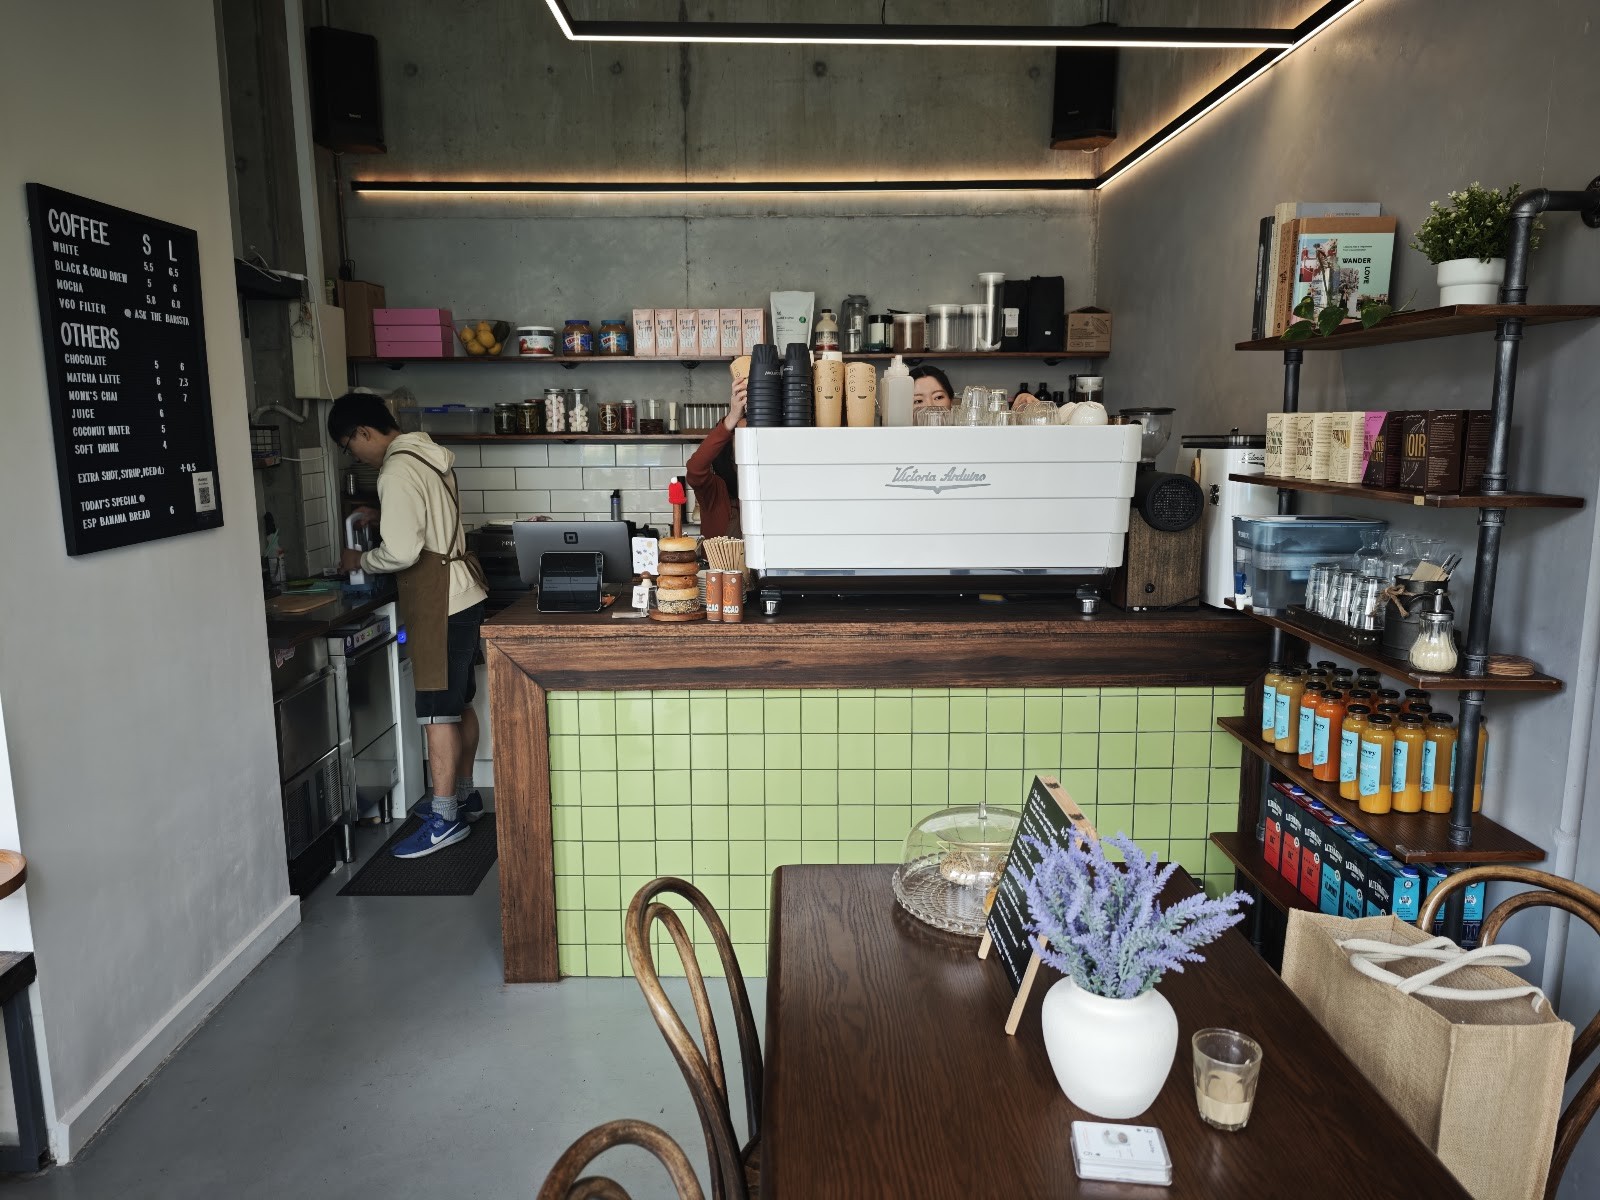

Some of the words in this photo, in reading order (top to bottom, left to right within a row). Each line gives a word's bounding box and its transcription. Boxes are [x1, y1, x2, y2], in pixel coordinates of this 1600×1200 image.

[48, 208, 110, 246] COFFEE
[142, 233, 151, 256] S
[168, 239, 178, 262] L
[52, 240, 80, 257] WHITE
[143, 261, 154, 273] 5.5
[168, 267, 179, 278] 6.5
[54, 259, 82, 275] BLACK
[82, 263, 90, 276] &
[90, 267, 107, 280] COLD
[109, 271, 128, 284] BREW
[147, 279, 152, 288] 5
[173, 284, 178, 293] 6
[1363, 266, 1371, 285] LOVE
[56, 278, 84, 293] MOCHA
[59, 297, 76, 310] V60
[79, 300, 106, 315] FILTER
[134, 309, 147, 320] ASK
[150, 311, 162, 322] THE
[165, 313, 190, 326] BARISTA
[60, 321, 120, 351] OTHERS
[64, 353, 107, 366] CHOCOLATE
[154, 360, 159, 370] 5
[180, 362, 185, 371] 6
[66, 371, 97, 384] MATCHA
[99, 373, 121, 385] LATTE
[156, 376, 161, 386] 6
[68, 390, 98, 401] MONK'S
[101, 391, 118, 402] CHAI
[157, 393, 163, 402] 6
[183, 393, 188, 402] 7
[71, 408, 95, 419] JUICE
[159, 408, 164, 418] 6
[72, 426, 105, 437] COCONUT
[107, 425, 130, 435] WATER
[161, 424, 166, 434] 5
[74, 444, 93, 455] SOFT
[98, 442, 119, 454] DRINK
[162, 440, 167, 450] 4
[77, 471, 99, 484] EXTRA
[892, 465, 936, 482] Victoria
[940, 466, 986, 482] Arduino
[80, 498, 110, 512] TODAY'S
[111, 494, 139, 507] SPECIAL
[82, 517, 97, 530] ESP
[99, 512, 127, 527] BANANA
[129, 509, 150, 522] BREAD
[169, 505, 175, 515] 6
